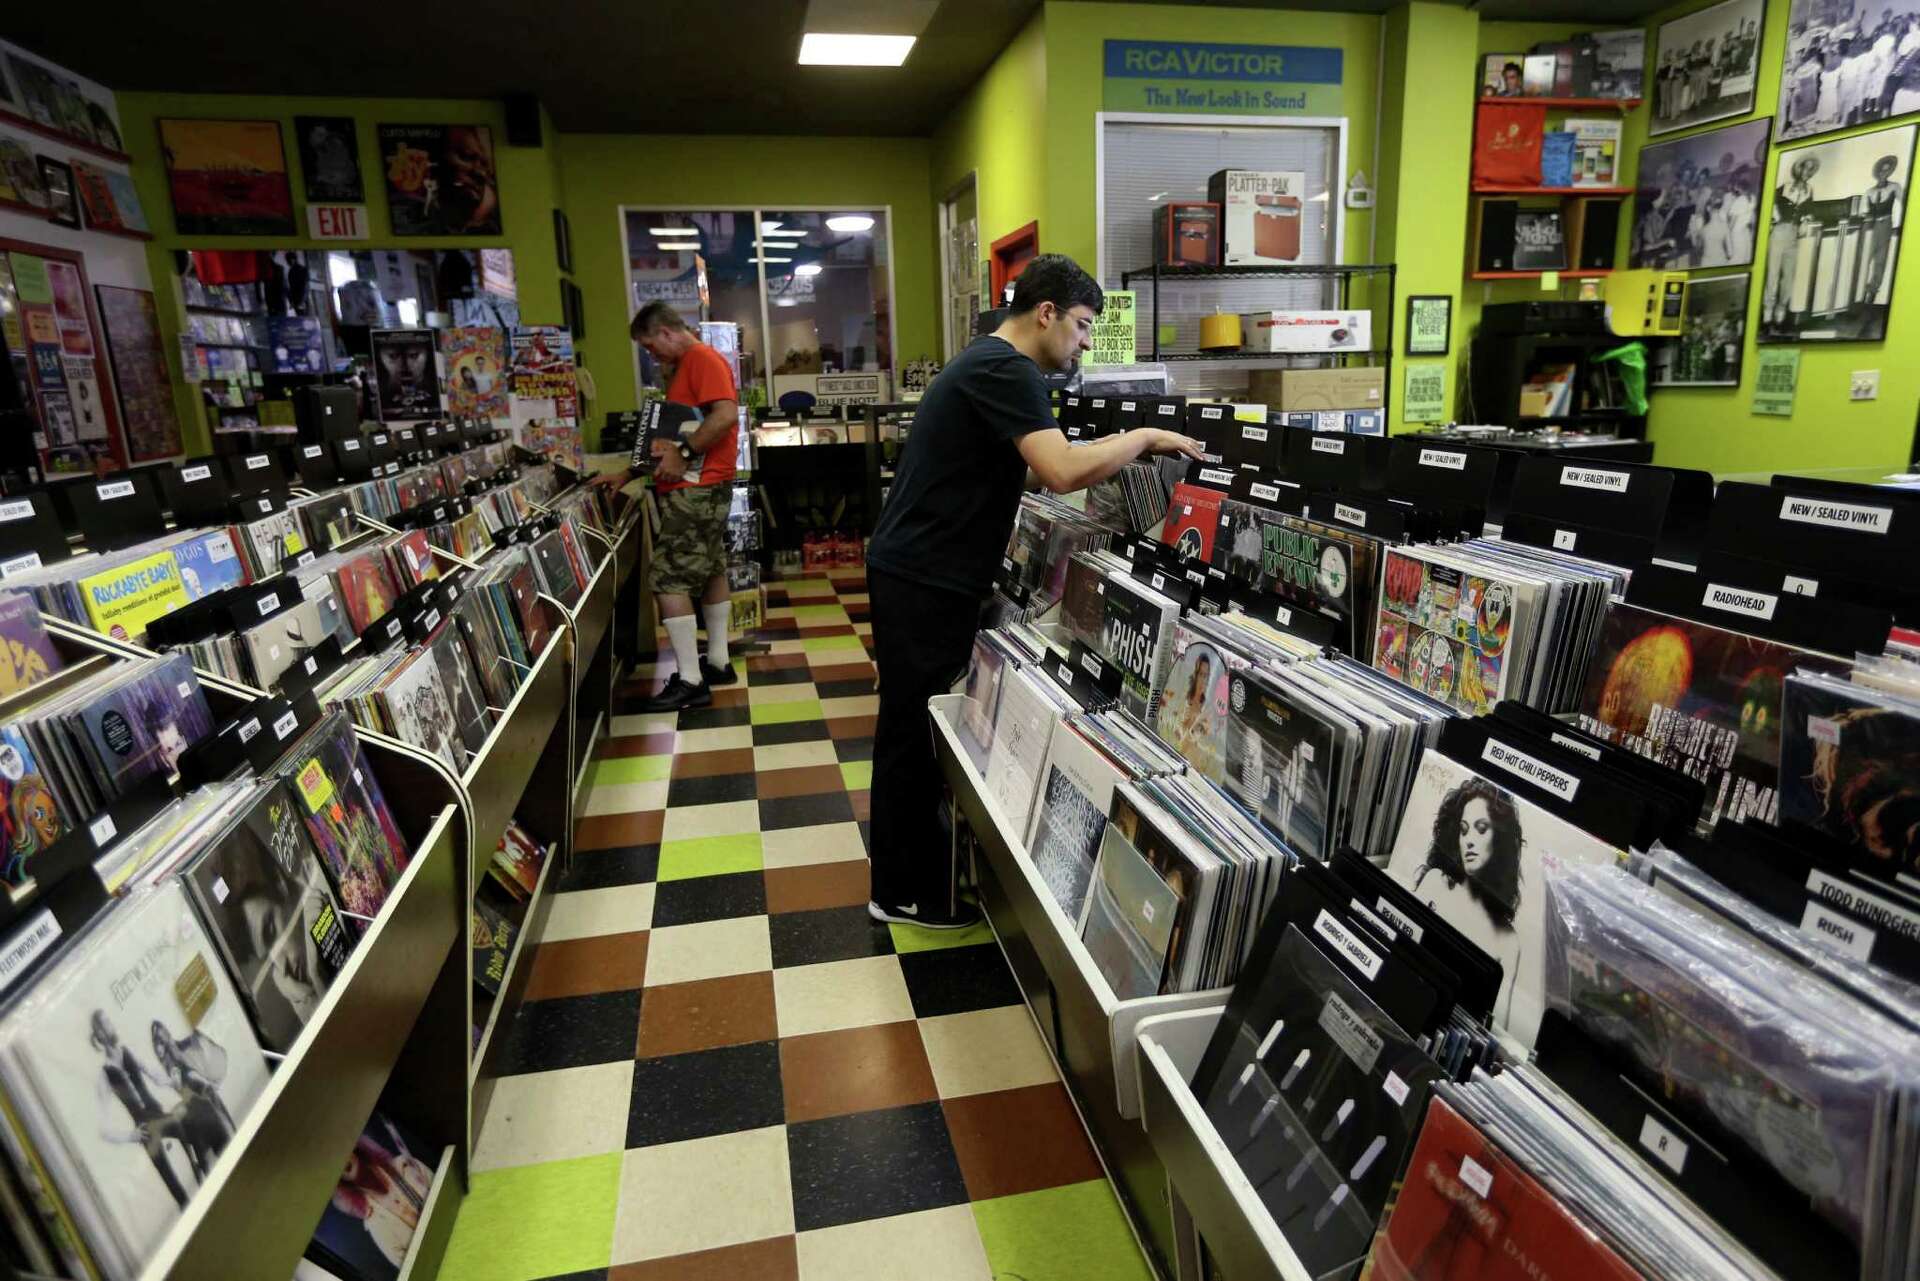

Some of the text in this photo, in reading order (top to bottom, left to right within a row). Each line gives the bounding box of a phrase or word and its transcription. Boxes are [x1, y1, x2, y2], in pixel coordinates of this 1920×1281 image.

[1144, 86, 1306, 110] The New Look in Sound
[1228, 177, 1289, 193] PLATTER-PAK
[318, 207, 357, 237] EXIT
[1109, 296, 1133, 309] LIMITED
[1108, 311, 1121, 324] JAM
[1097, 325, 1133, 337] ANNIVERSARY
[1100, 338, 1107, 350] LP
[1107, 338, 1119, 350] BOX
[1120, 338, 1133, 350] SETS
[1092, 352, 1124, 364] AVAILABLE
[1423, 453, 1432, 461] NEW
[1435, 454, 1448, 464] SEALED
[1449, 456, 1461, 465] VINYL
[1566, 471, 1579, 481] NEW
[1584, 473, 1603, 485] SEALED
[1604, 477, 1621, 487] VINYL
[1337, 507, 1350, 519] PUBLIC
[1789, 503, 1810, 516] NEW
[1817, 506, 1850, 521] SEALED
[1851, 511, 1878, 525] VINYL
[1263, 524, 1320, 566] PUBLIC
[1562, 535, 1568, 544] P
[91, 558, 177, 607] ROCKABYE BABY!
[1713, 591, 1765, 611] RADIOHEAD
[1110, 618, 1157, 682] PHISH
[1148, 689, 1161, 719] PHISH
[1645, 703, 1739, 769] RADIOHEAD
[1489, 746, 1570, 791] RED HOT CHILI PEPPERS
[1820, 881, 1853, 906] TODD
[1817, 917, 1855, 944] RUSH
[1, 922, 50, 976] FLEETWOOD MAC
[1322, 920, 1343, 944] RODRIGO
[1346, 943, 1372, 970] GABRIELA
[1658, 1135, 1669, 1151] R
